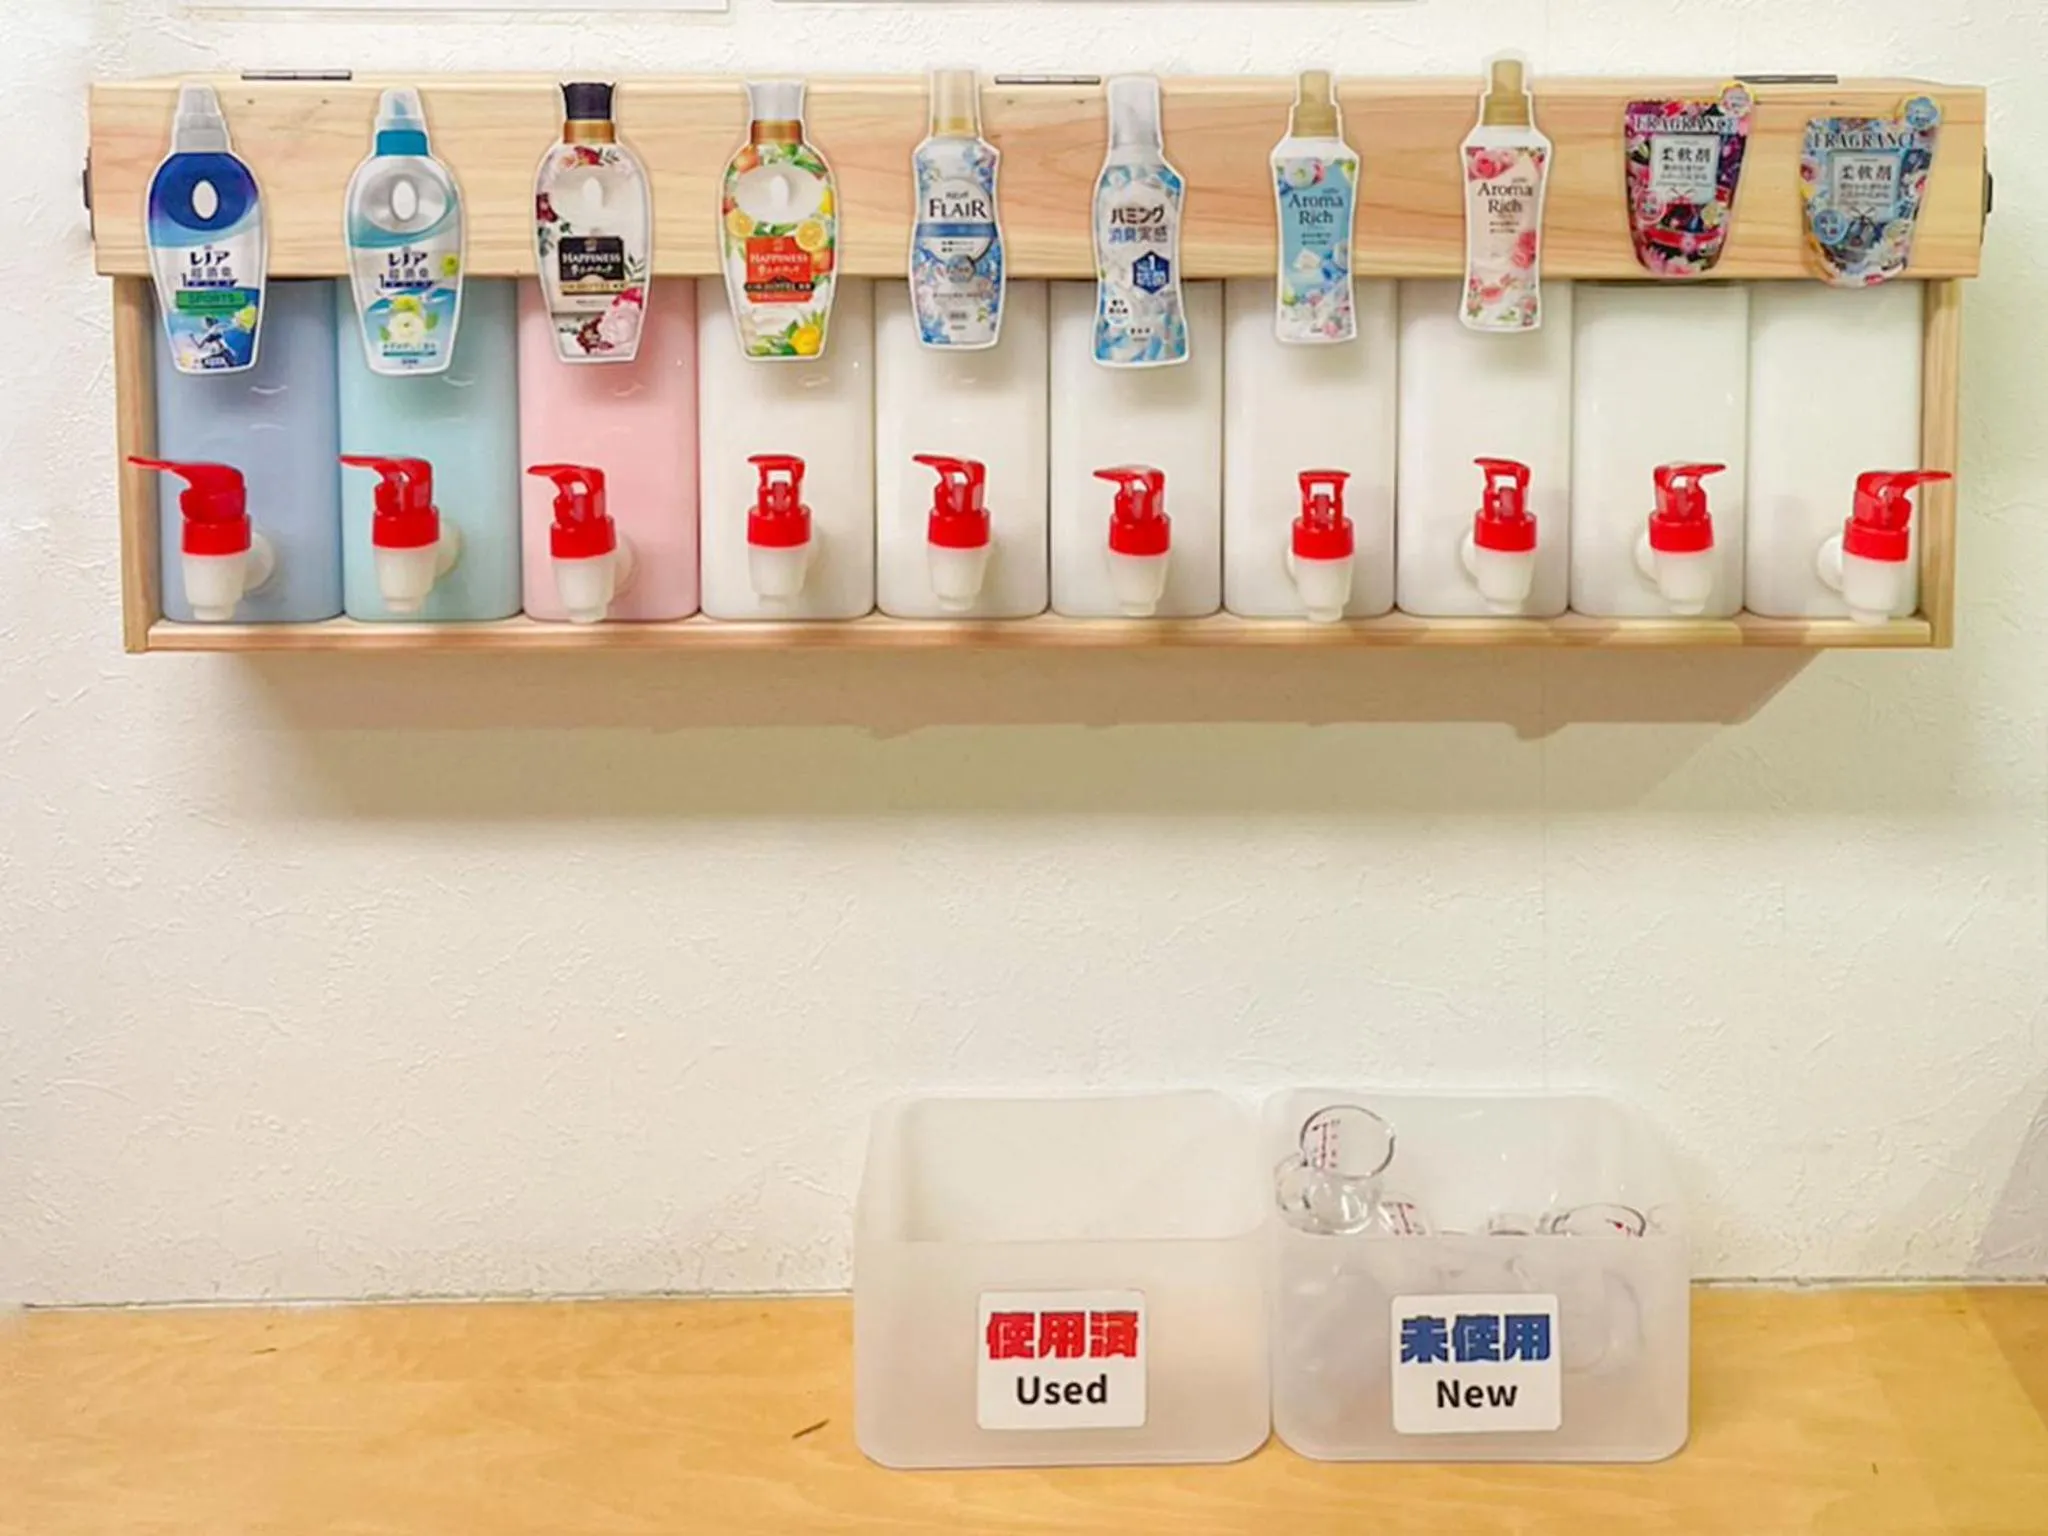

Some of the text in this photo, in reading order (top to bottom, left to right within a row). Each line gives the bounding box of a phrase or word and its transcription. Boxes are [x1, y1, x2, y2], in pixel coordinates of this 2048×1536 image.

[1661, 148, 1711, 163] 柔軟剤
[1841, 164, 1893, 181] 柔軟剤
[1477, 182, 1533, 197] Aroma
[1288, 193, 1344, 208] Aroma
[1488, 199, 1523, 214] Rich
[928, 199, 988, 218] FLAIR
[1111, 204, 1166, 225] ハミング
[1298, 210, 1335, 225] Rich
[1108, 225, 1168, 243] 消臭実感
[190, 251, 231, 266] レノア
[388, 252, 428, 267] レノア
[561, 253, 622, 263] HAPPINESS
[751, 253, 809, 263] HAPPINESS
[987, 1311, 1138, 1359] 使用済
[1400, 1314, 1551, 1363] 未使用
[1016, 1373, 1107, 1405] Used
[1436, 1379, 1518, 1408] New
